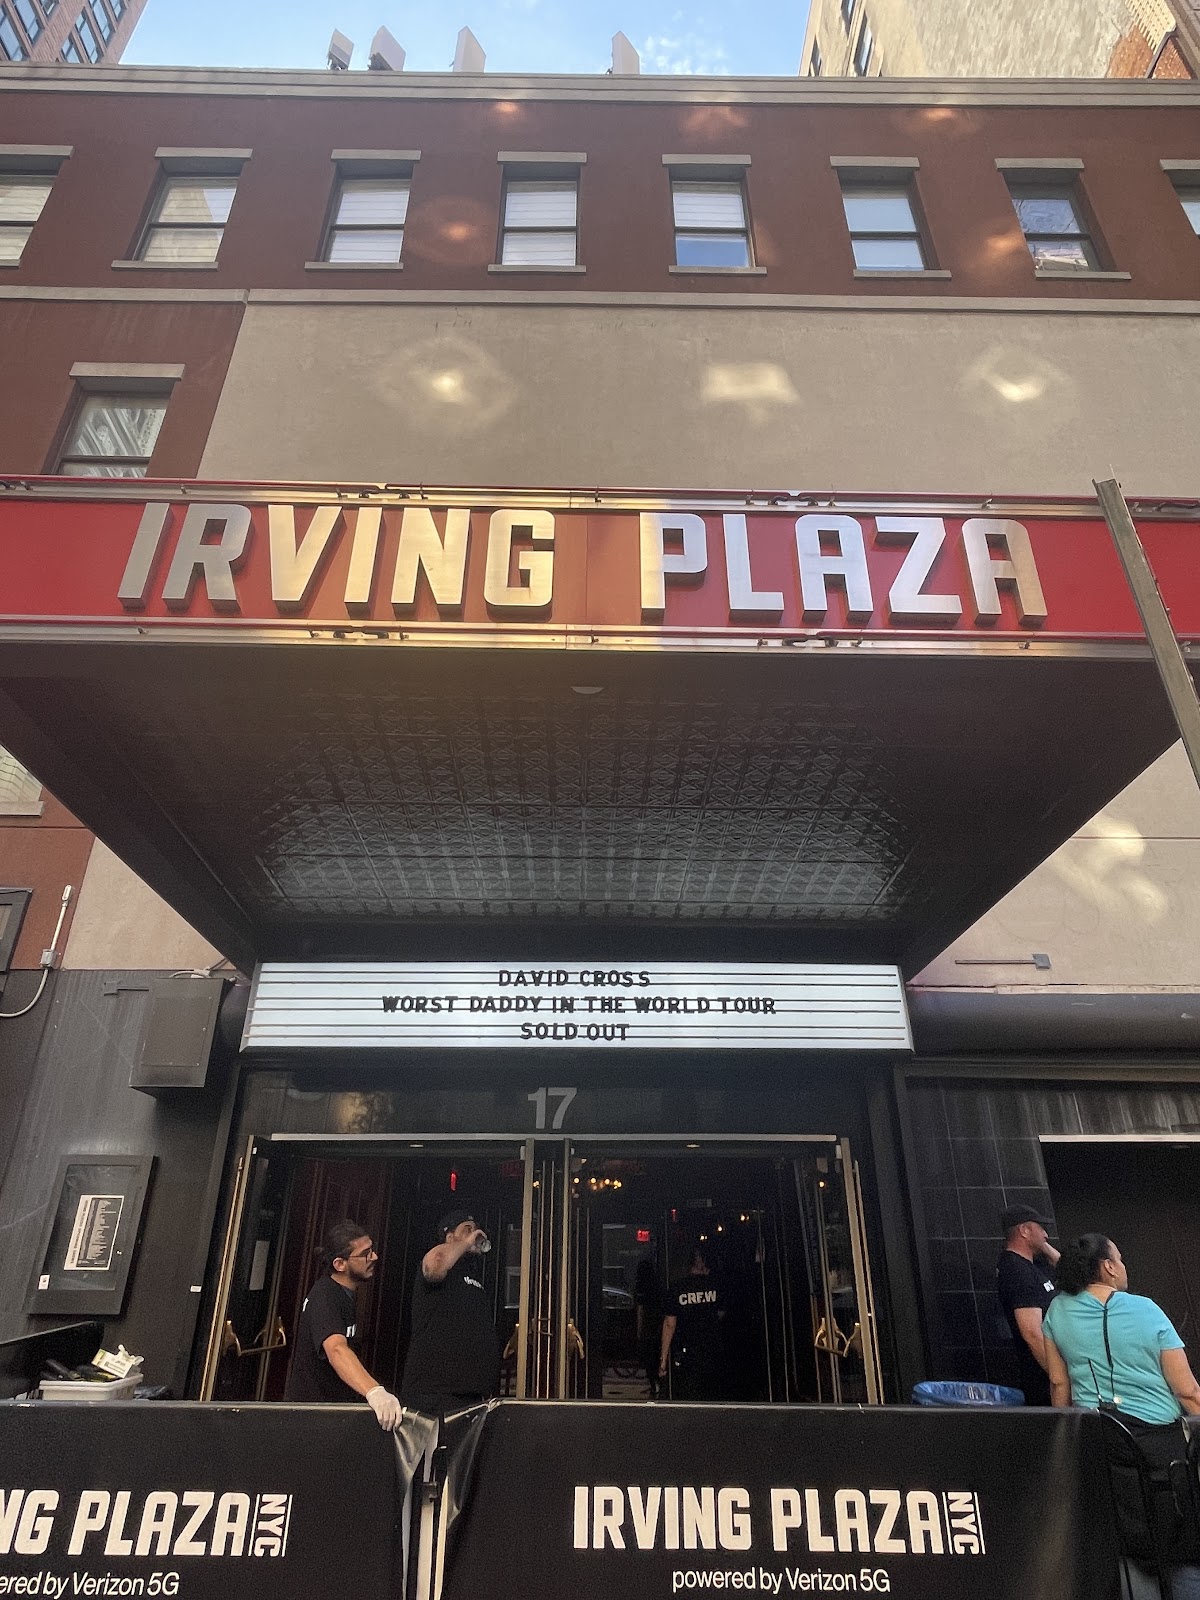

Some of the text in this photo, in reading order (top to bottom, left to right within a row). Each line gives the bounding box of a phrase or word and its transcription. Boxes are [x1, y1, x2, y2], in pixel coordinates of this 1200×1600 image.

[118, 502, 1048, 621] IRVING PLAZA
[499, 970, 650, 988] DAVID CROSS
[382, 996, 777, 1015] WORST DADDY IN THE WORLD TOUR
[520, 1023, 629, 1041] SOLD OUT
[527, 1087, 577, 1130] 17
[679, 1290, 717, 1306] CREW
[68, 1491, 251, 1556] PLAZA
[253, 1493, 286, 1556] NYC
[573, 1486, 981, 1555] IRVING PLAZA NYC
[43, 1572, 69, 1599] by
[72, 1574, 144, 1596] Verizon
[147, 1573, 180, 1595] 5G
[673, 1567, 890, 1593] powered by Verizon 5G
